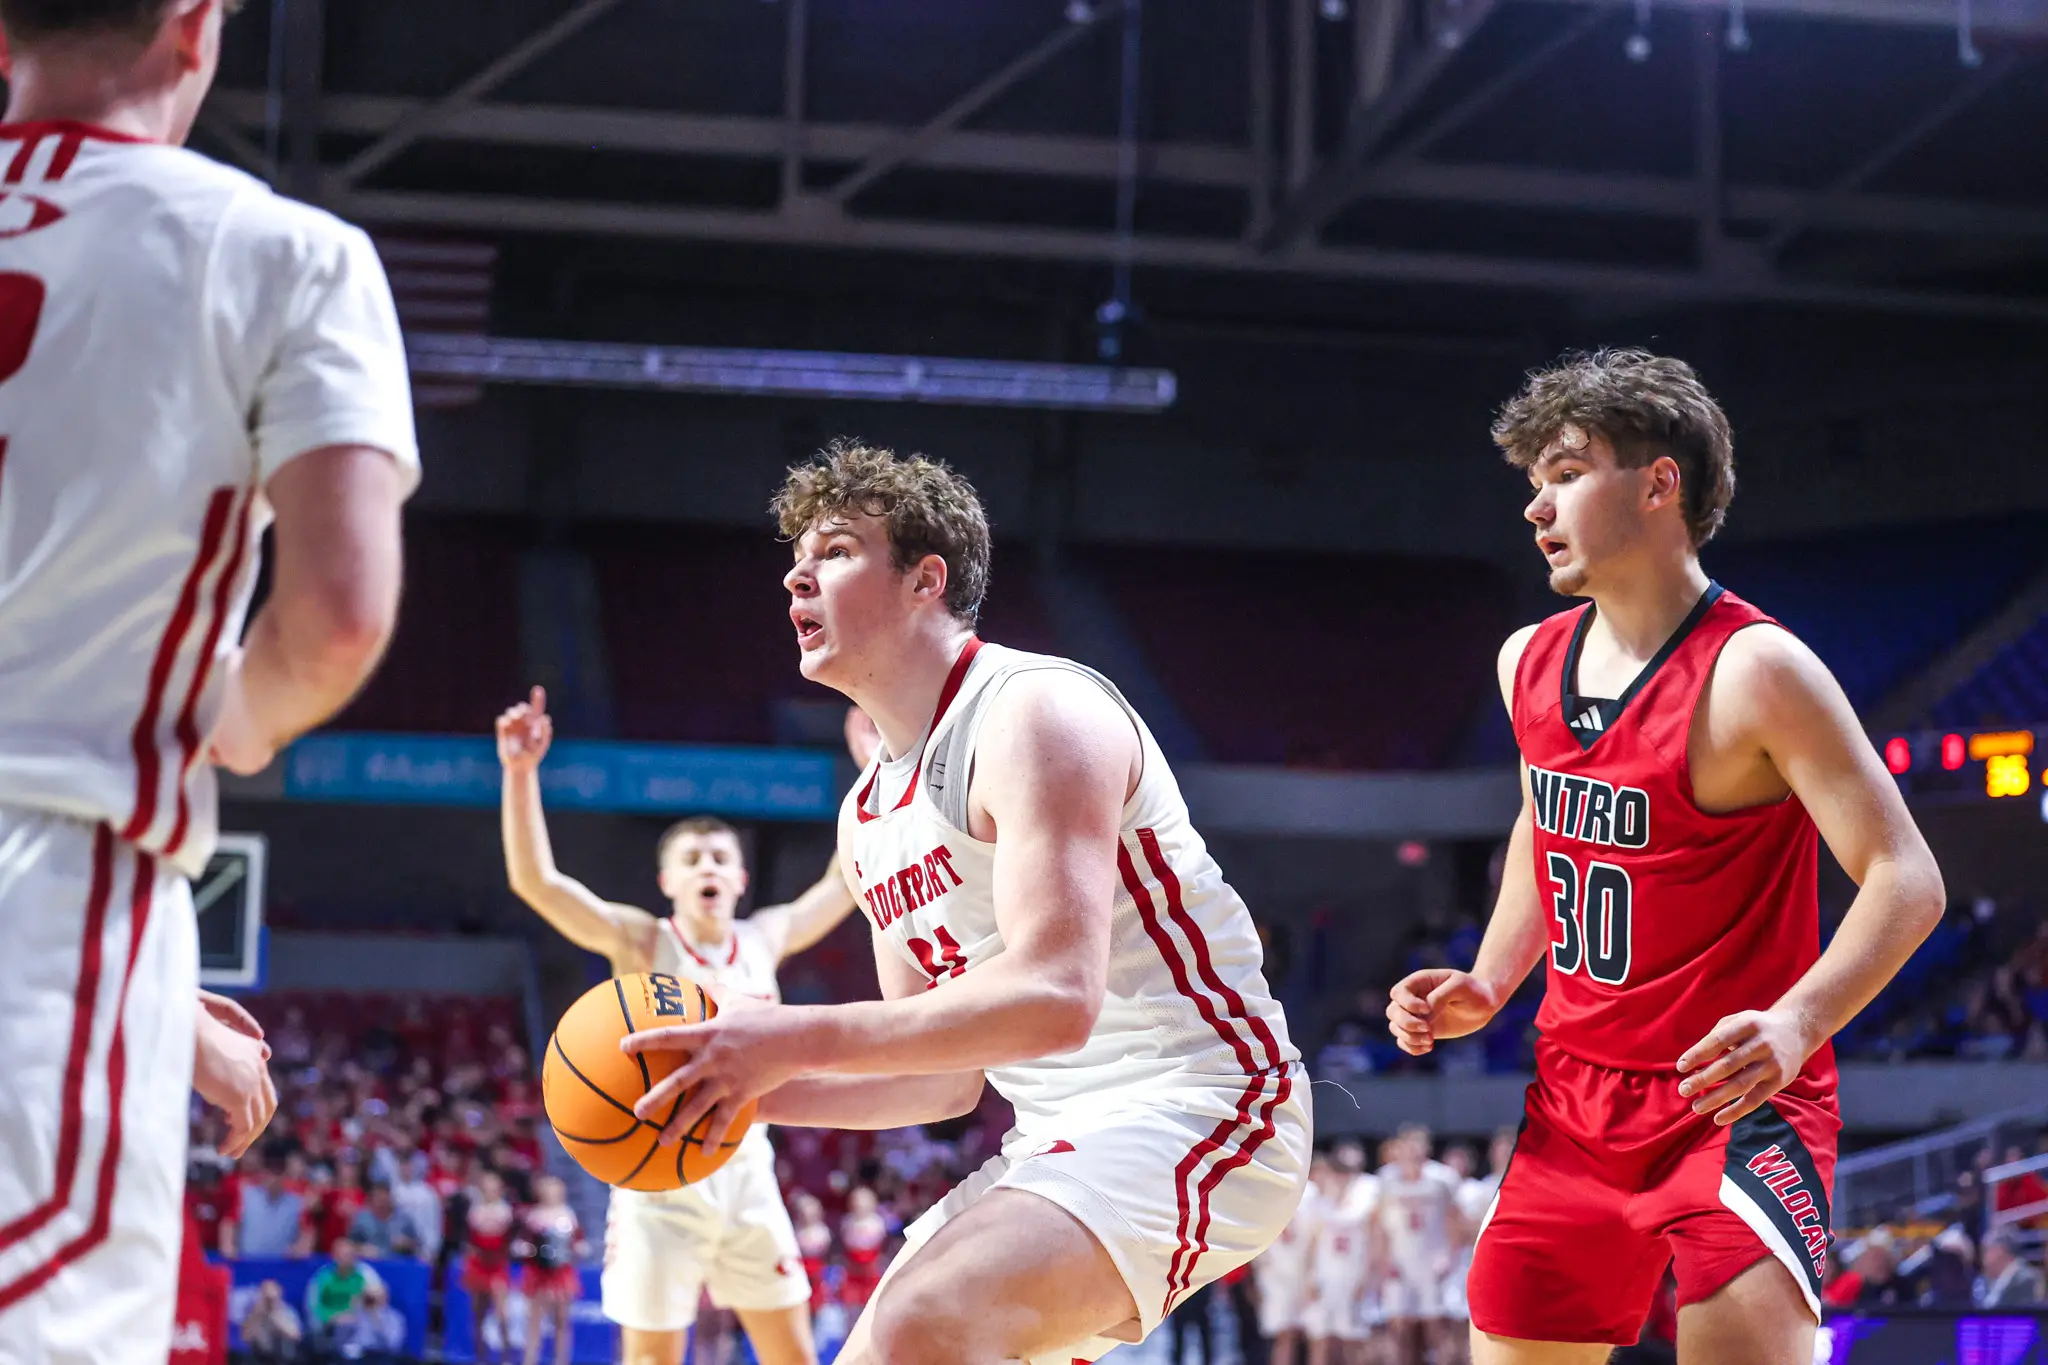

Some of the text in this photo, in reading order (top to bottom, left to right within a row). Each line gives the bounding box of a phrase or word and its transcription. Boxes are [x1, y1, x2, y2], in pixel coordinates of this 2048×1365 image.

[1528, 764, 1649, 849] NITRO
[1546, 851, 1632, 986] 30
[1745, 1144, 1828, 1278] WILDCATS
